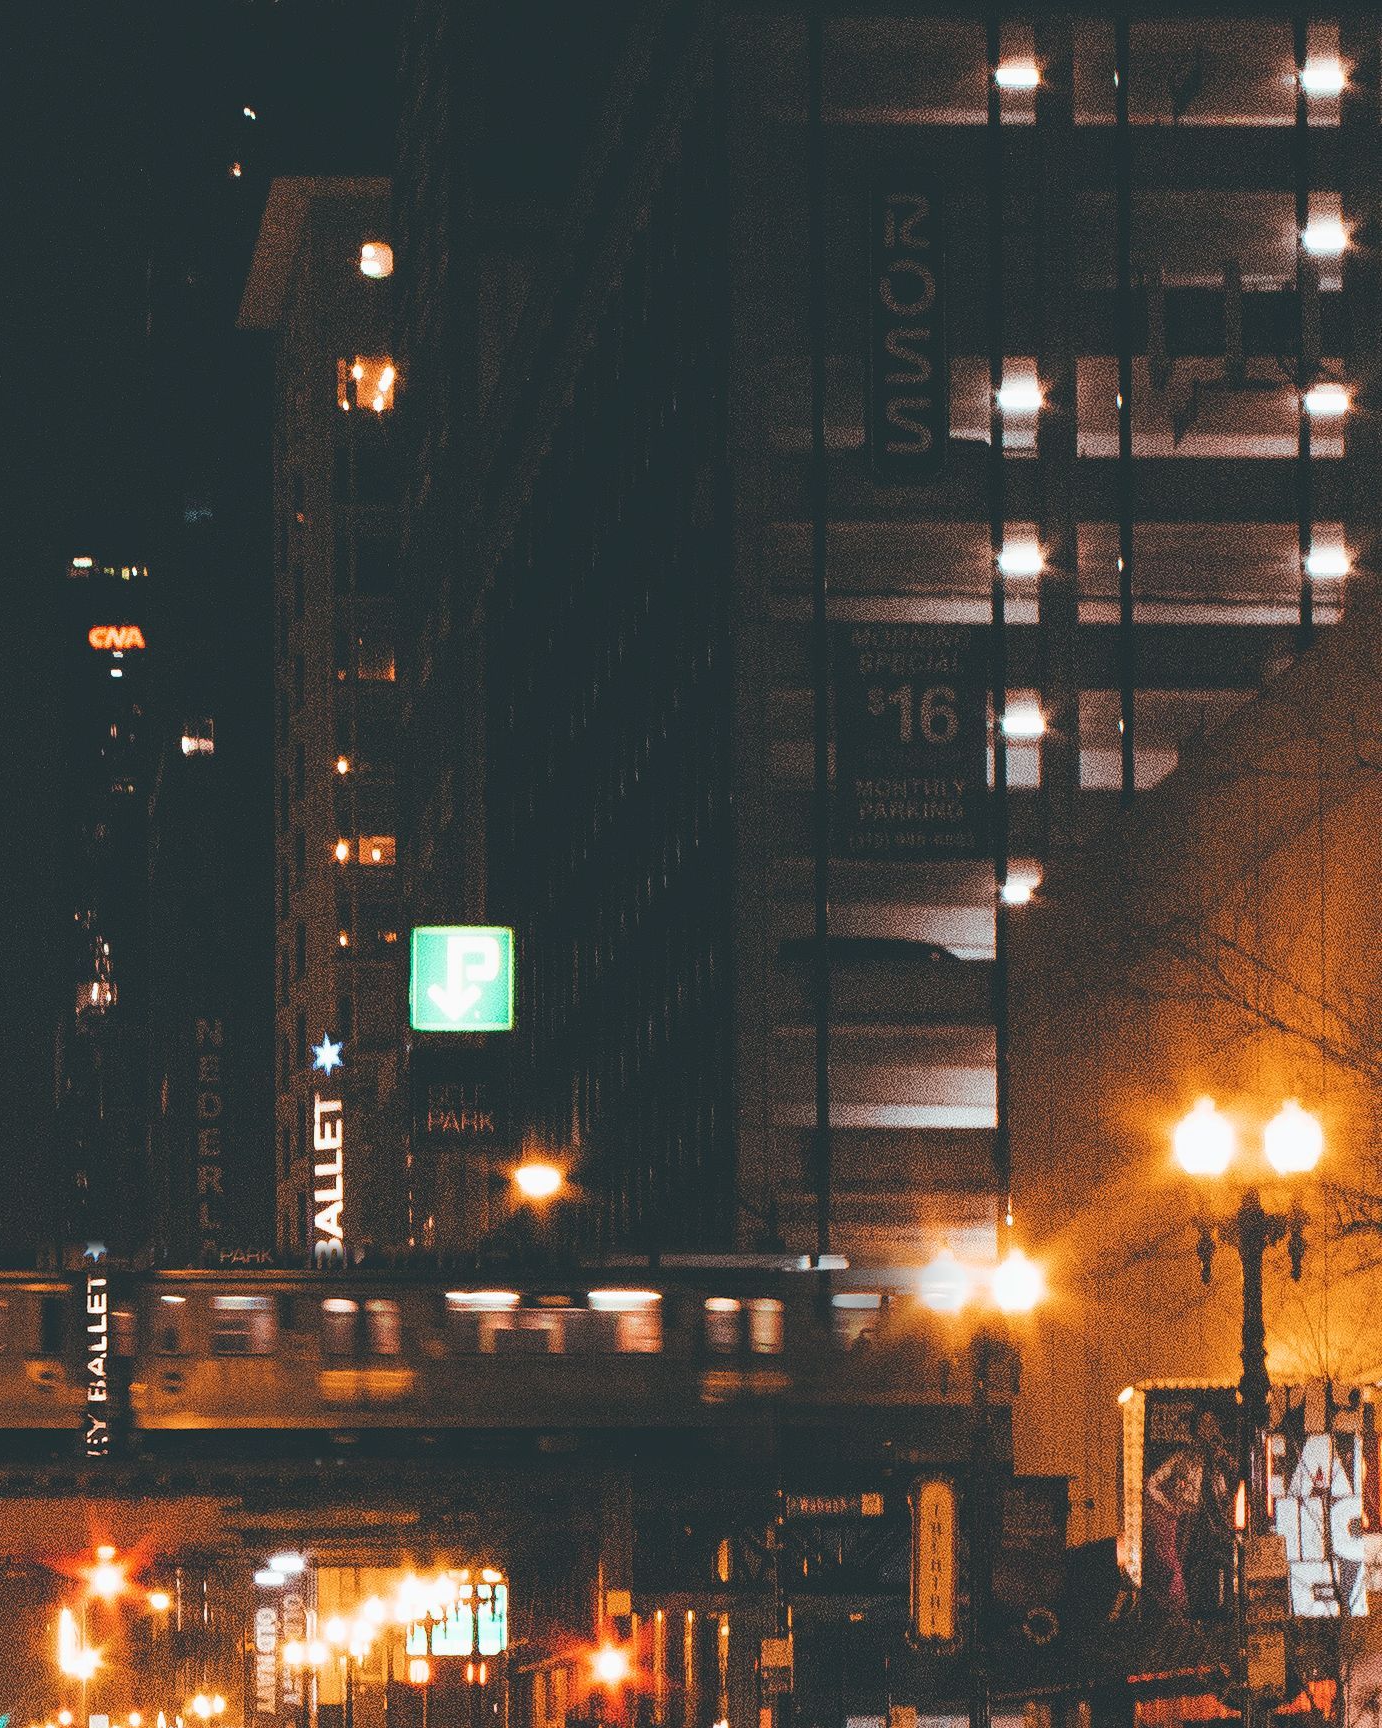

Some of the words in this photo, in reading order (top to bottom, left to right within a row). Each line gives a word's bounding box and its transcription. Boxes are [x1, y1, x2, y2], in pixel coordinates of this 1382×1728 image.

[880, 193, 936, 457] ROSS
[88, 625, 146, 650] CNA
[858, 652, 962, 675] SPECIAL
[866, 684, 960, 745] $16
[855, 779, 966, 798] MONTHLY
[859, 800, 965, 821] PARKING
[427, 1110, 495, 1133] PARK
[219, 1246, 274, 1263] PARK
[87, 1275, 109, 1402] BALLET
